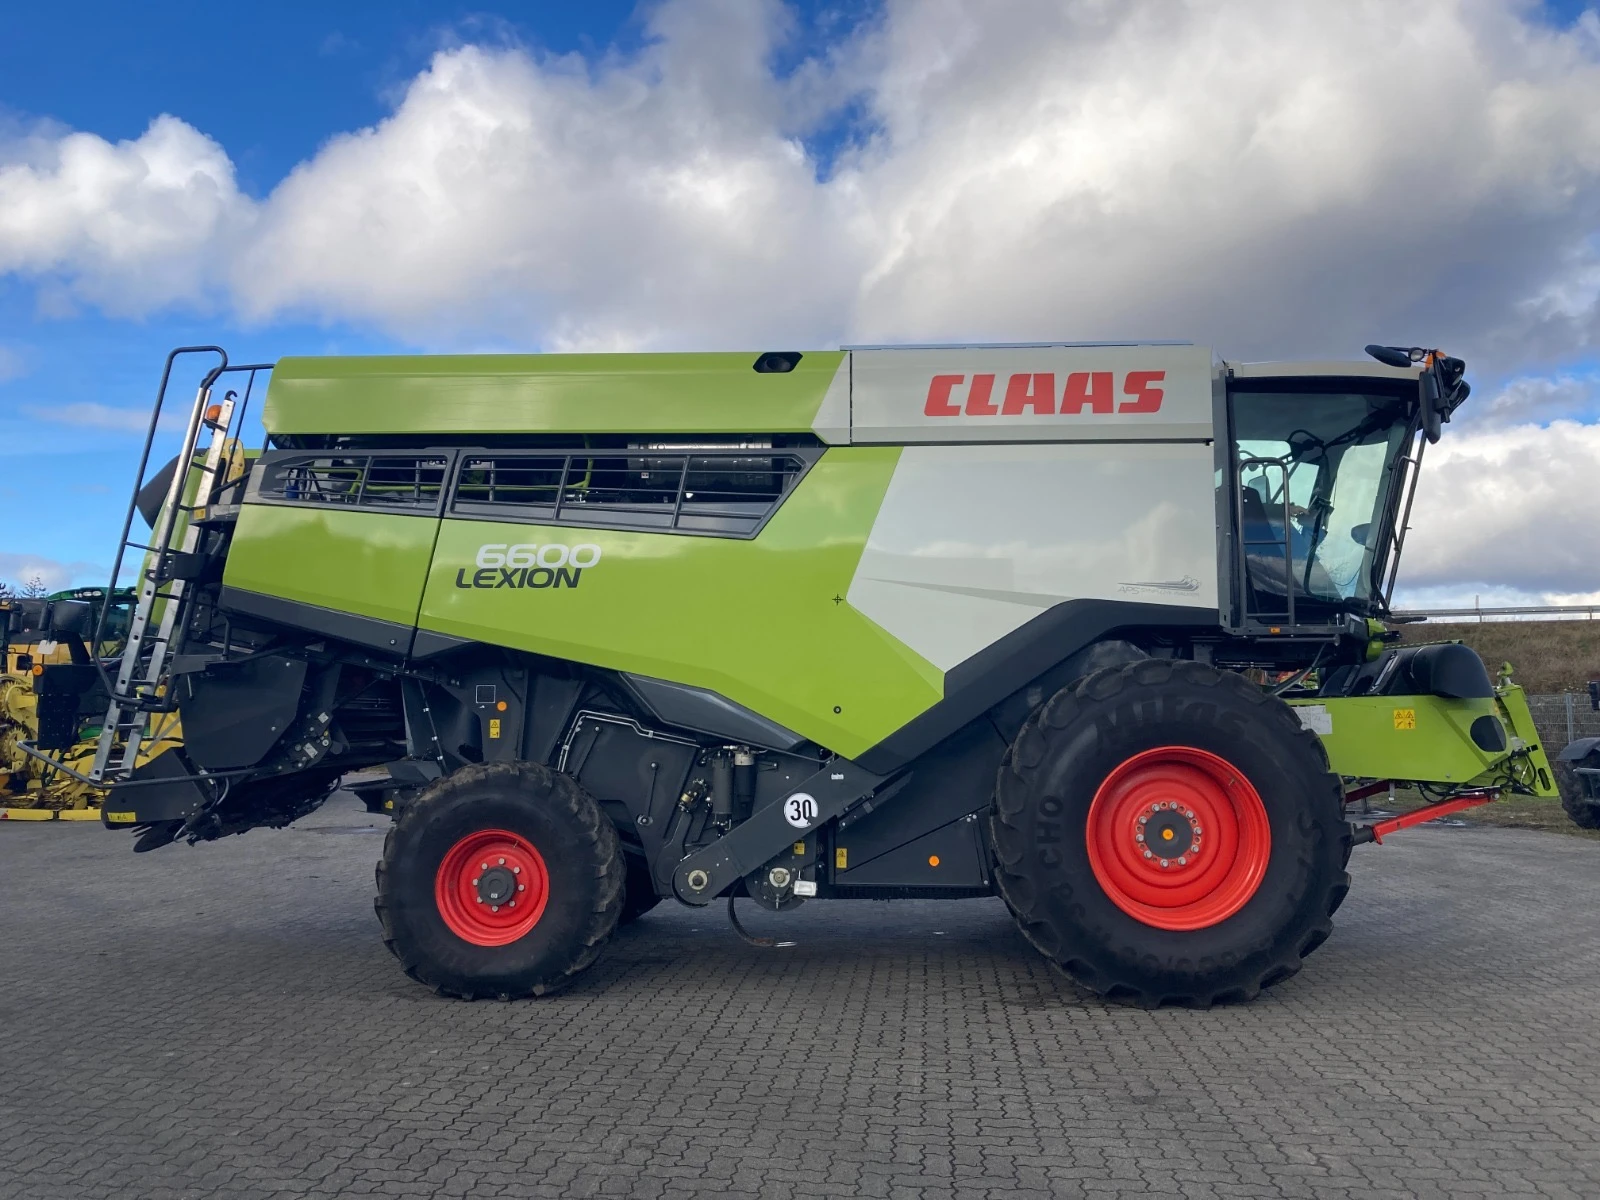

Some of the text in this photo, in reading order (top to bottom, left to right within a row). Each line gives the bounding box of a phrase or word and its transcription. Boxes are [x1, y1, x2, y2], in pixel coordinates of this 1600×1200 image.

[924, 371, 1166, 416] CLAAS
[476, 544, 602, 568] 6600
[455, 568, 582, 588] LEXION
[790, 800, 813, 821] 30
[1037, 795, 1063, 870] CHO
